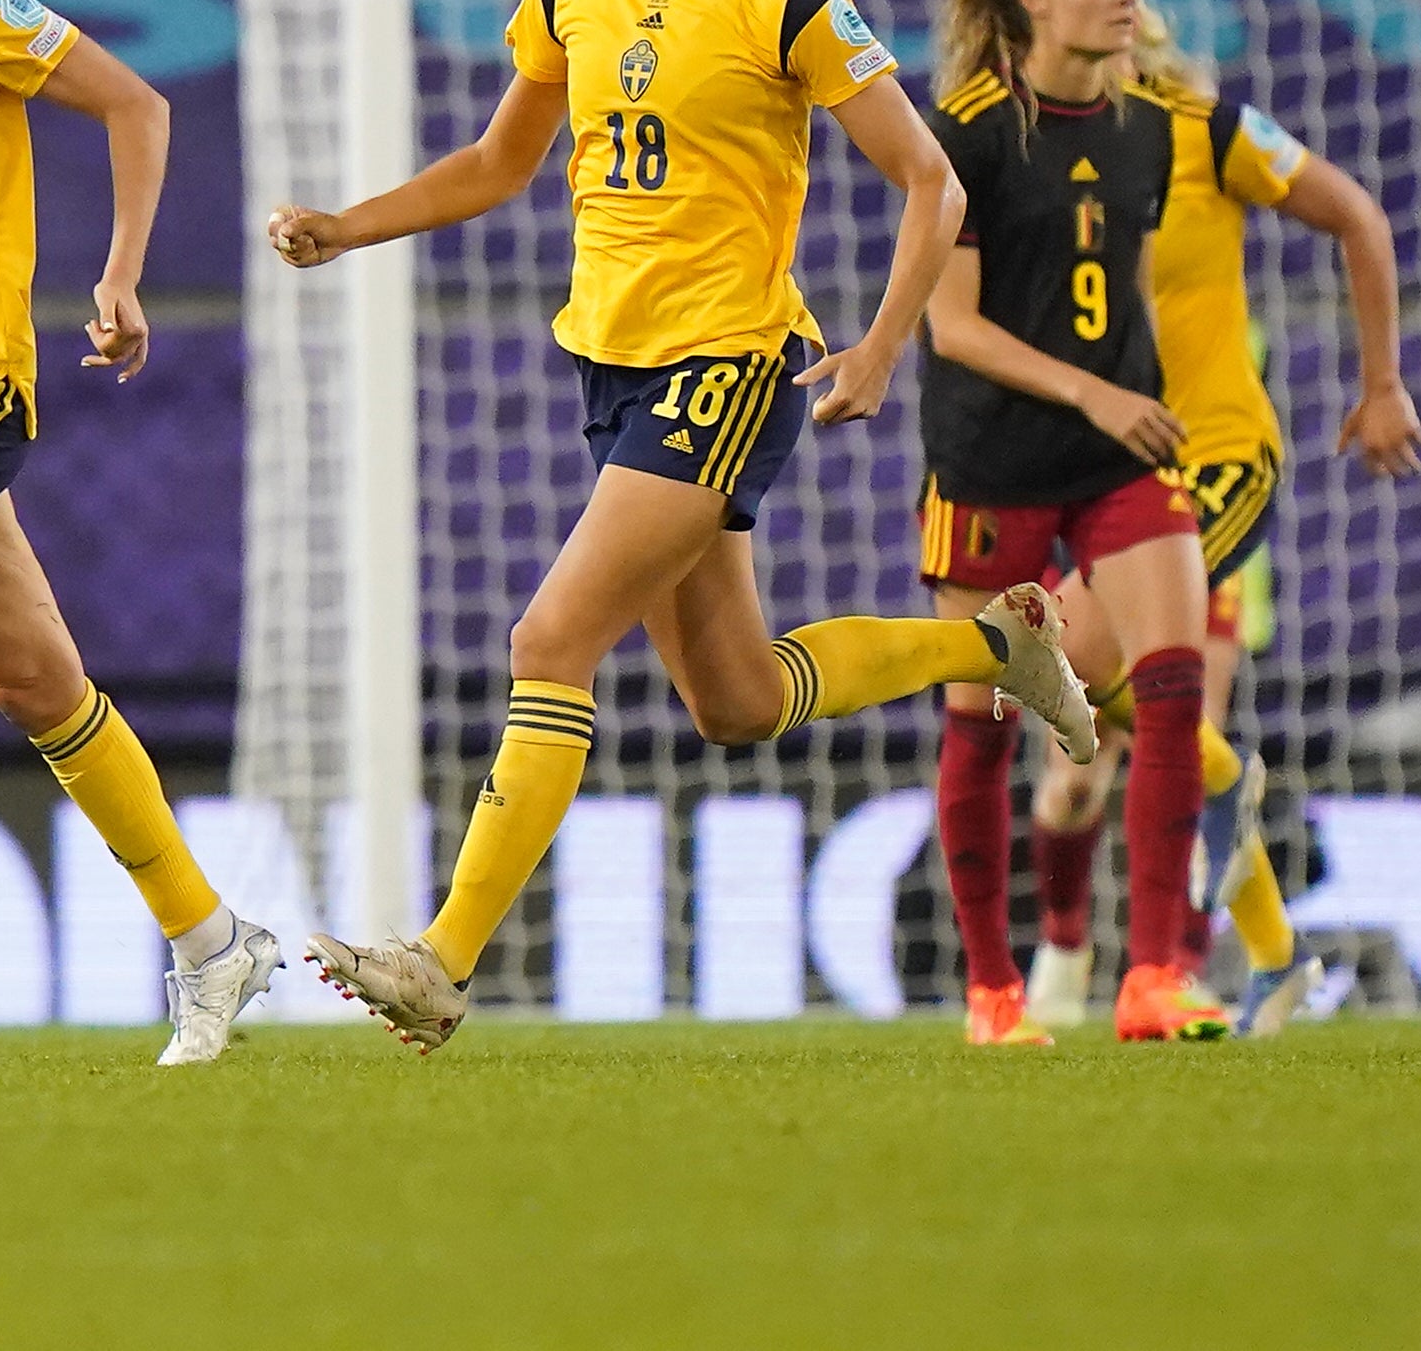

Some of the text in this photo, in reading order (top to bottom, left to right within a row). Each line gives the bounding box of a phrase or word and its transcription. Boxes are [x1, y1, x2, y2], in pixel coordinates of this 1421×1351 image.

[606, 111, 669, 191] 18
[1071, 260, 1109, 342] 9
[650, 361, 741, 428] 18
[661, 437, 695, 455] adidas
